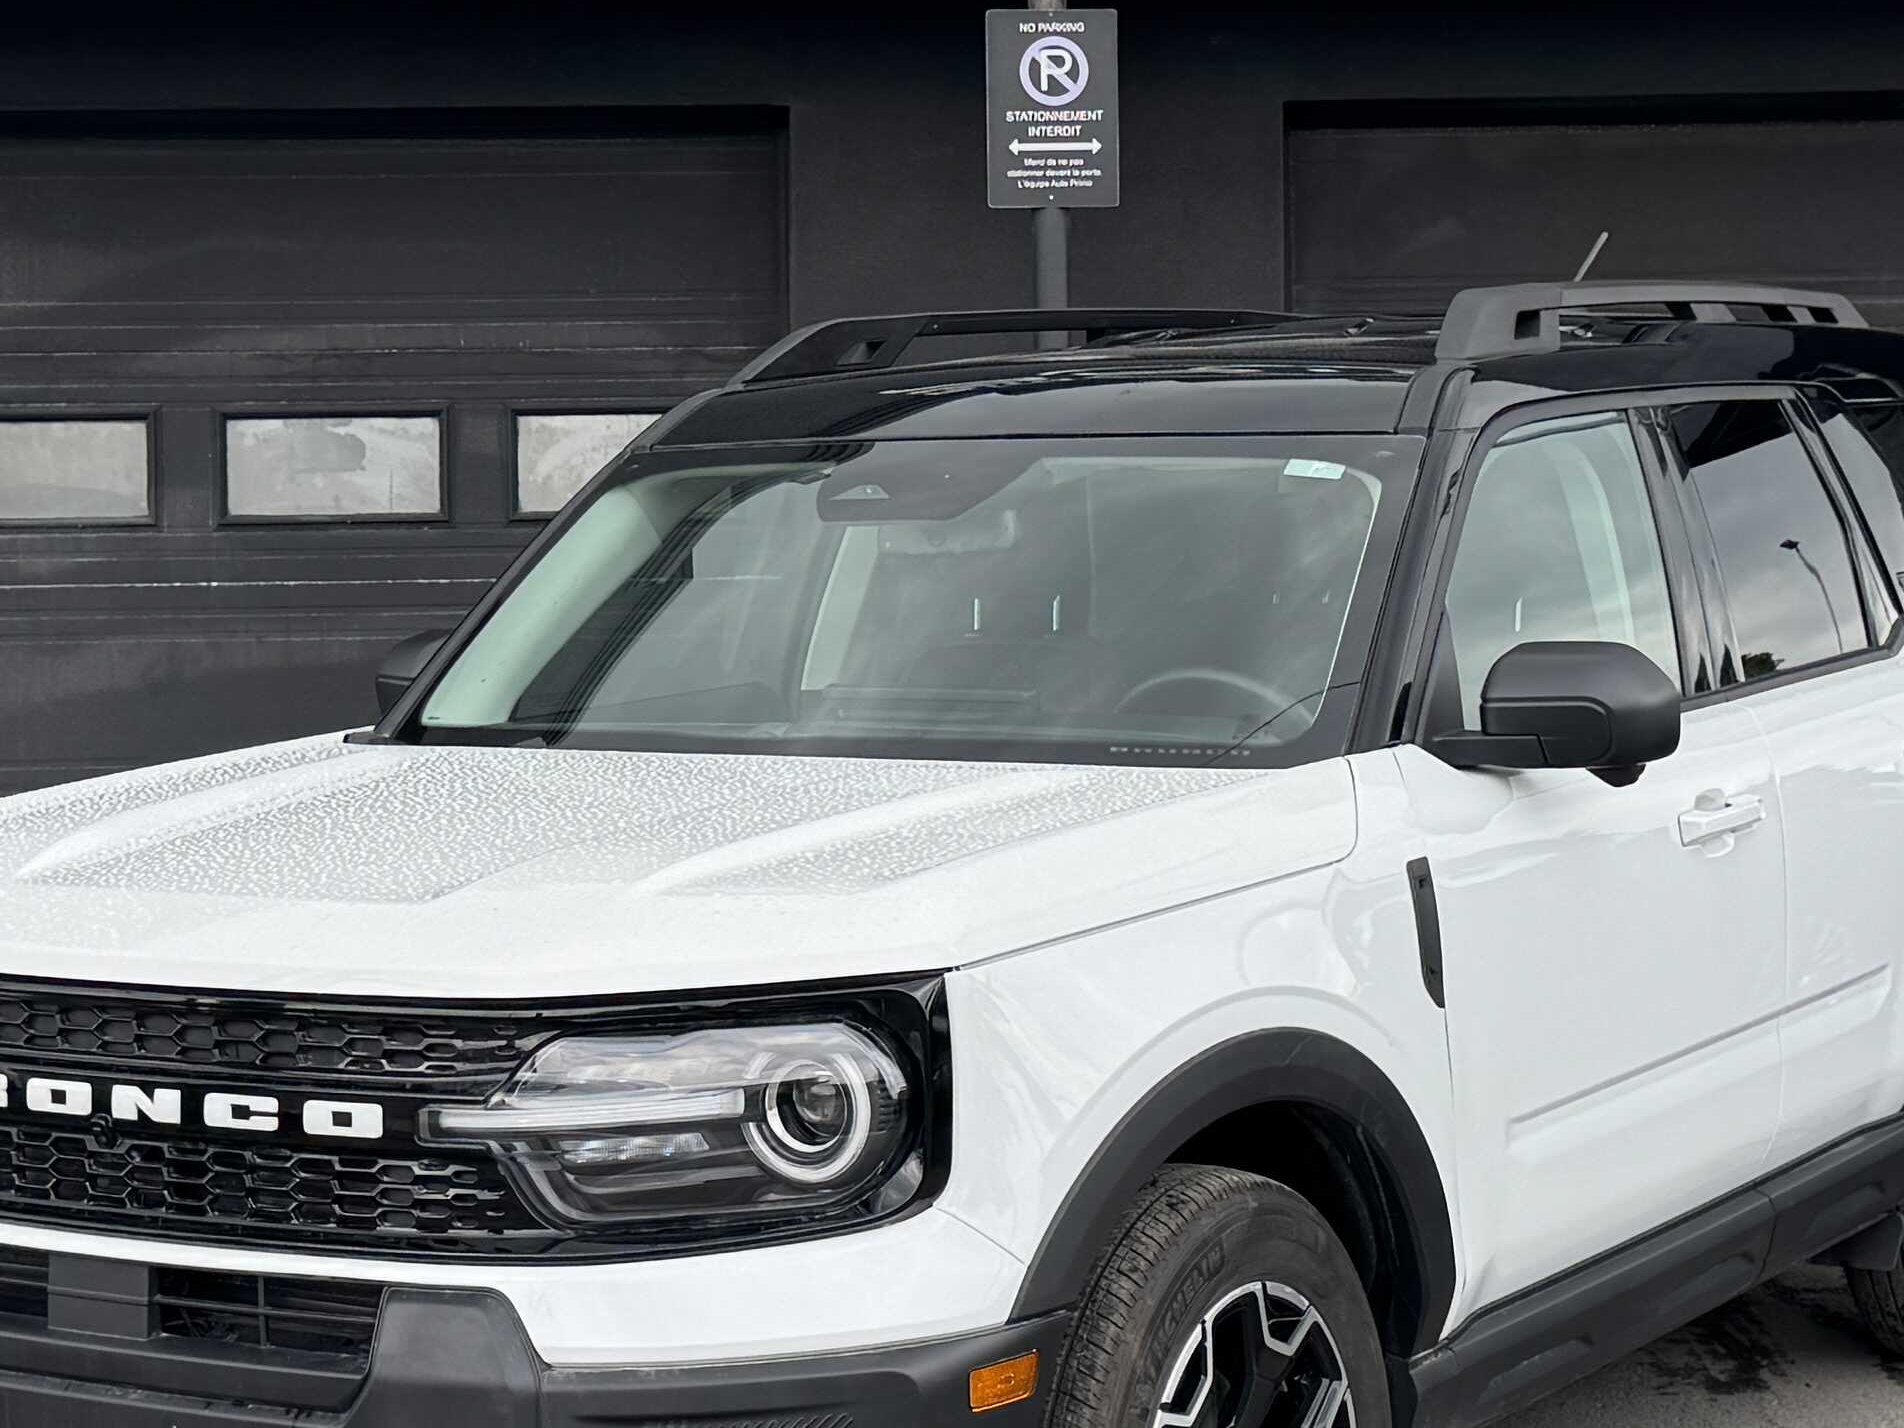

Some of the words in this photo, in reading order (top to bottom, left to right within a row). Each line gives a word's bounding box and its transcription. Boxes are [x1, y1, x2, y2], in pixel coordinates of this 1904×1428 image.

[1019, 22, 1036, 33] NO
[1038, 22, 1085, 32] PARKING
[1006, 110, 1104, 122] STATIONNEMENT
[1028, 125, 1082, 137] INTERDIT
